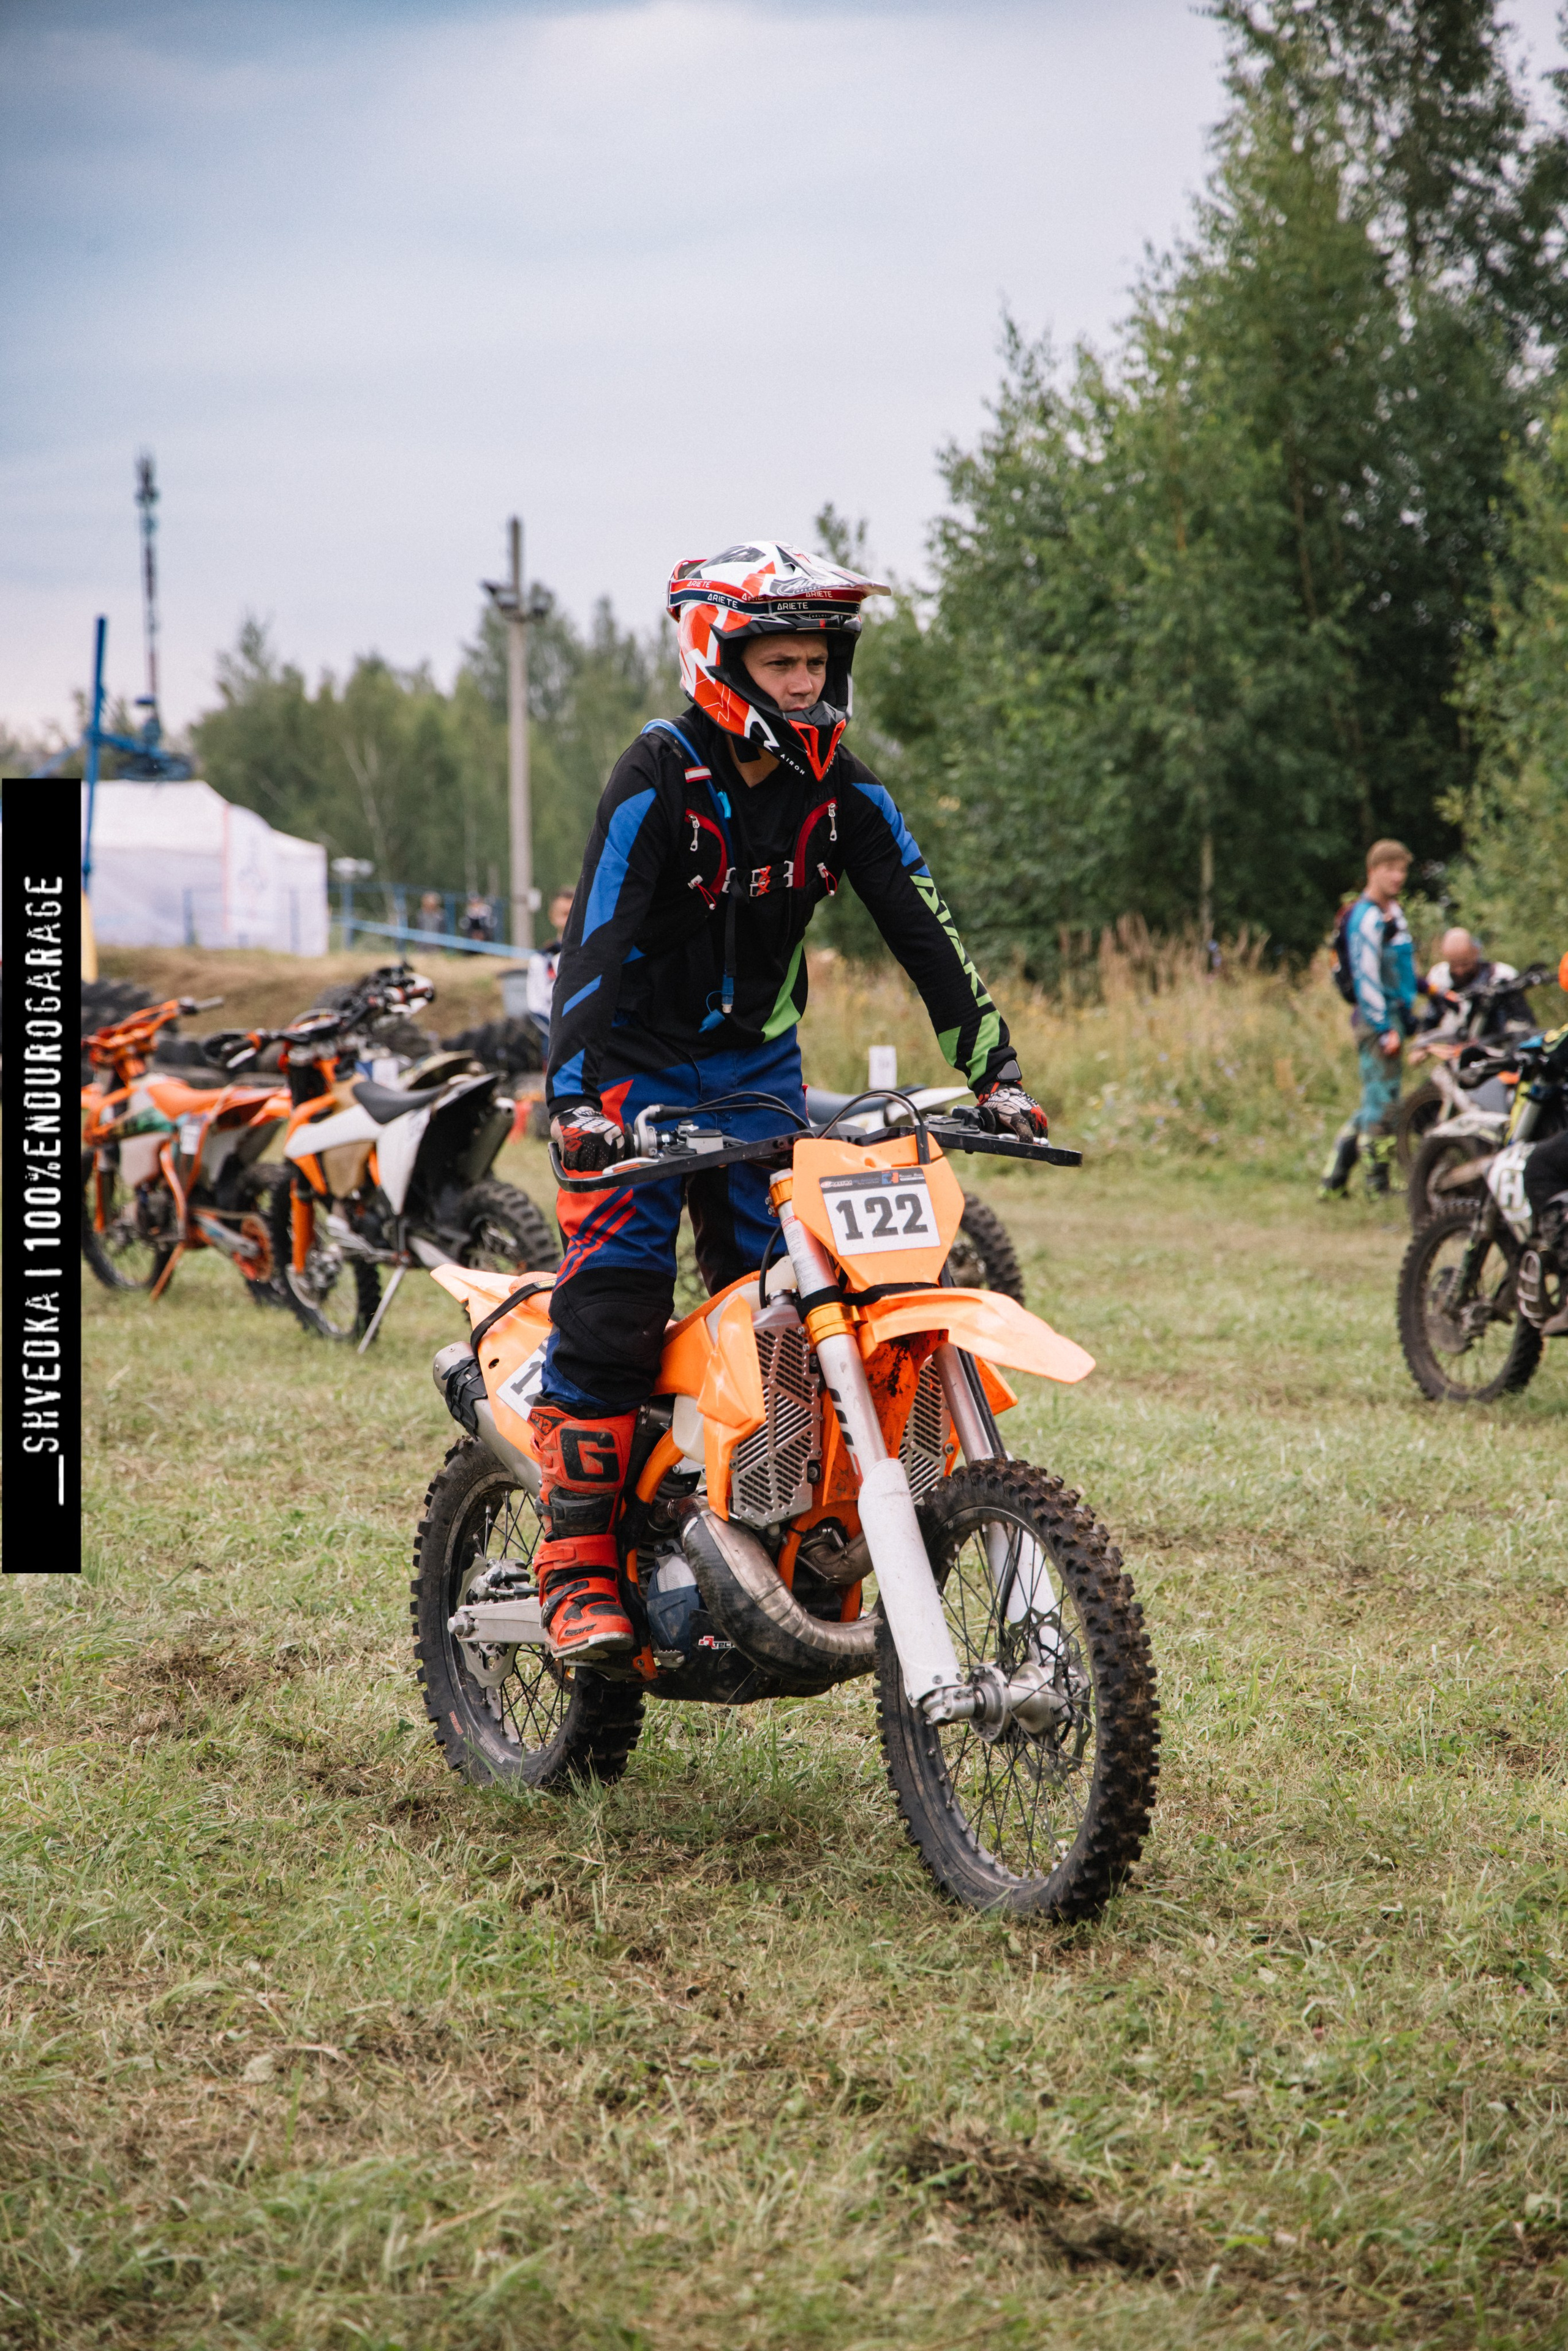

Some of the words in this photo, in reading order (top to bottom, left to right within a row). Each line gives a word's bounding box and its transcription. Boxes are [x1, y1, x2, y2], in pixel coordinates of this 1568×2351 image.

[707, 593, 738, 609] ARIETE
[780, 753, 805, 775] AIROH
[835, 1193, 929, 1240] 122
[560, 1428, 620, 1483] G
[449, 1710, 464, 1735] KENDA
